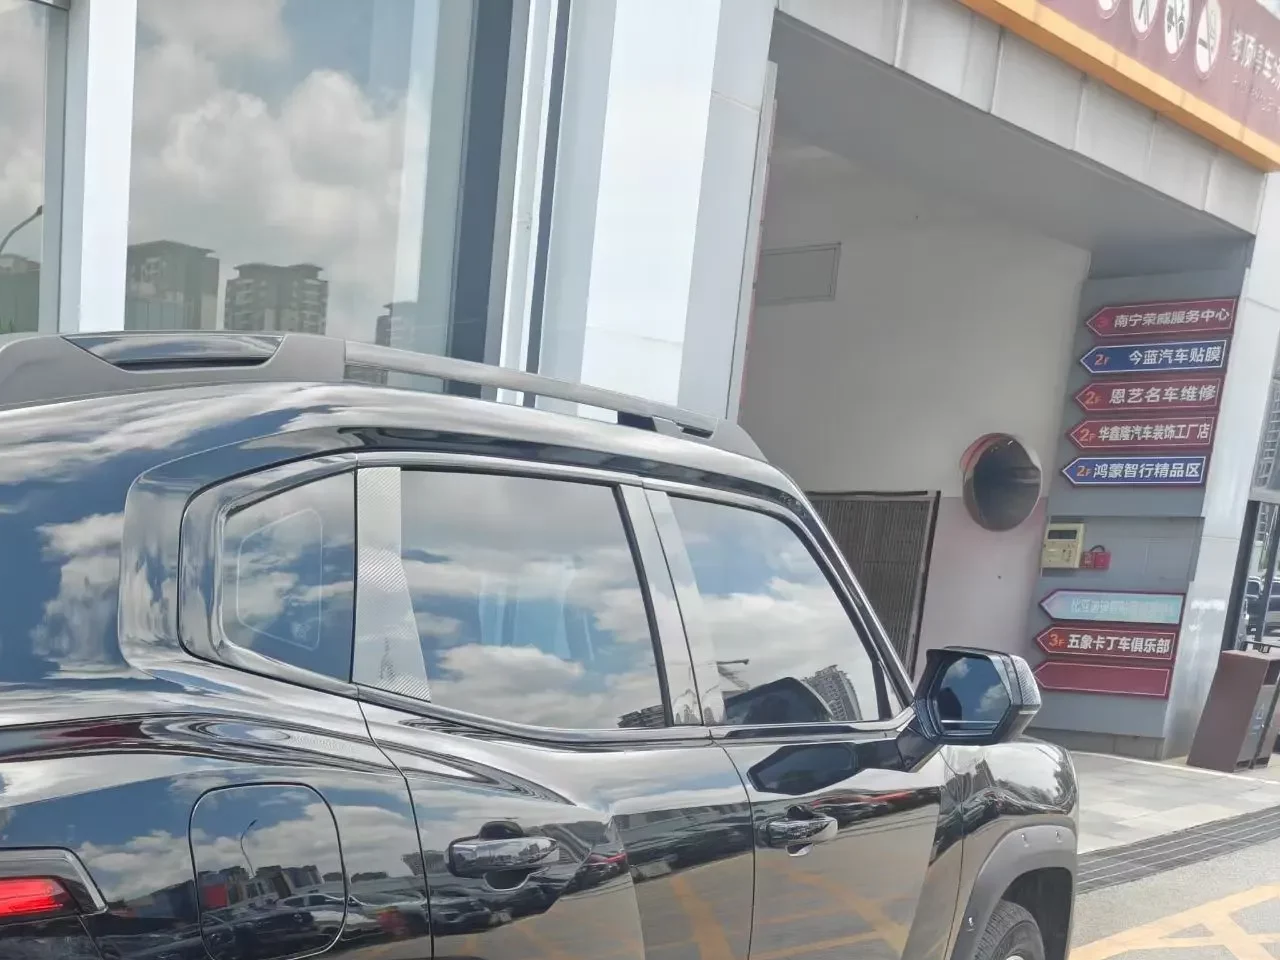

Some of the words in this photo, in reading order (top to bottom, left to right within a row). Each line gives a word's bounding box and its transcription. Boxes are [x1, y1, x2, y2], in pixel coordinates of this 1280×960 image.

[1114, 308, 1230, 328] 南宁荣威服务中心
[1129, 346, 1222, 365] 今蓝汽车贴膜
[1085, 390, 1102, 404] 2F
[1109, 384, 1216, 404] 恩艺名车维修
[1079, 428, 1096, 442] 2F
[1098, 423, 1211, 442] 华鑫隆汽车装饰工厂店
[1076, 465, 1091, 477] 2F
[1093, 462, 1202, 478] 鸿蒙智行精品区
[1049, 633, 1065, 647] 3F
[1067, 634, 1171, 654] 五象卡丁车俱乐部
